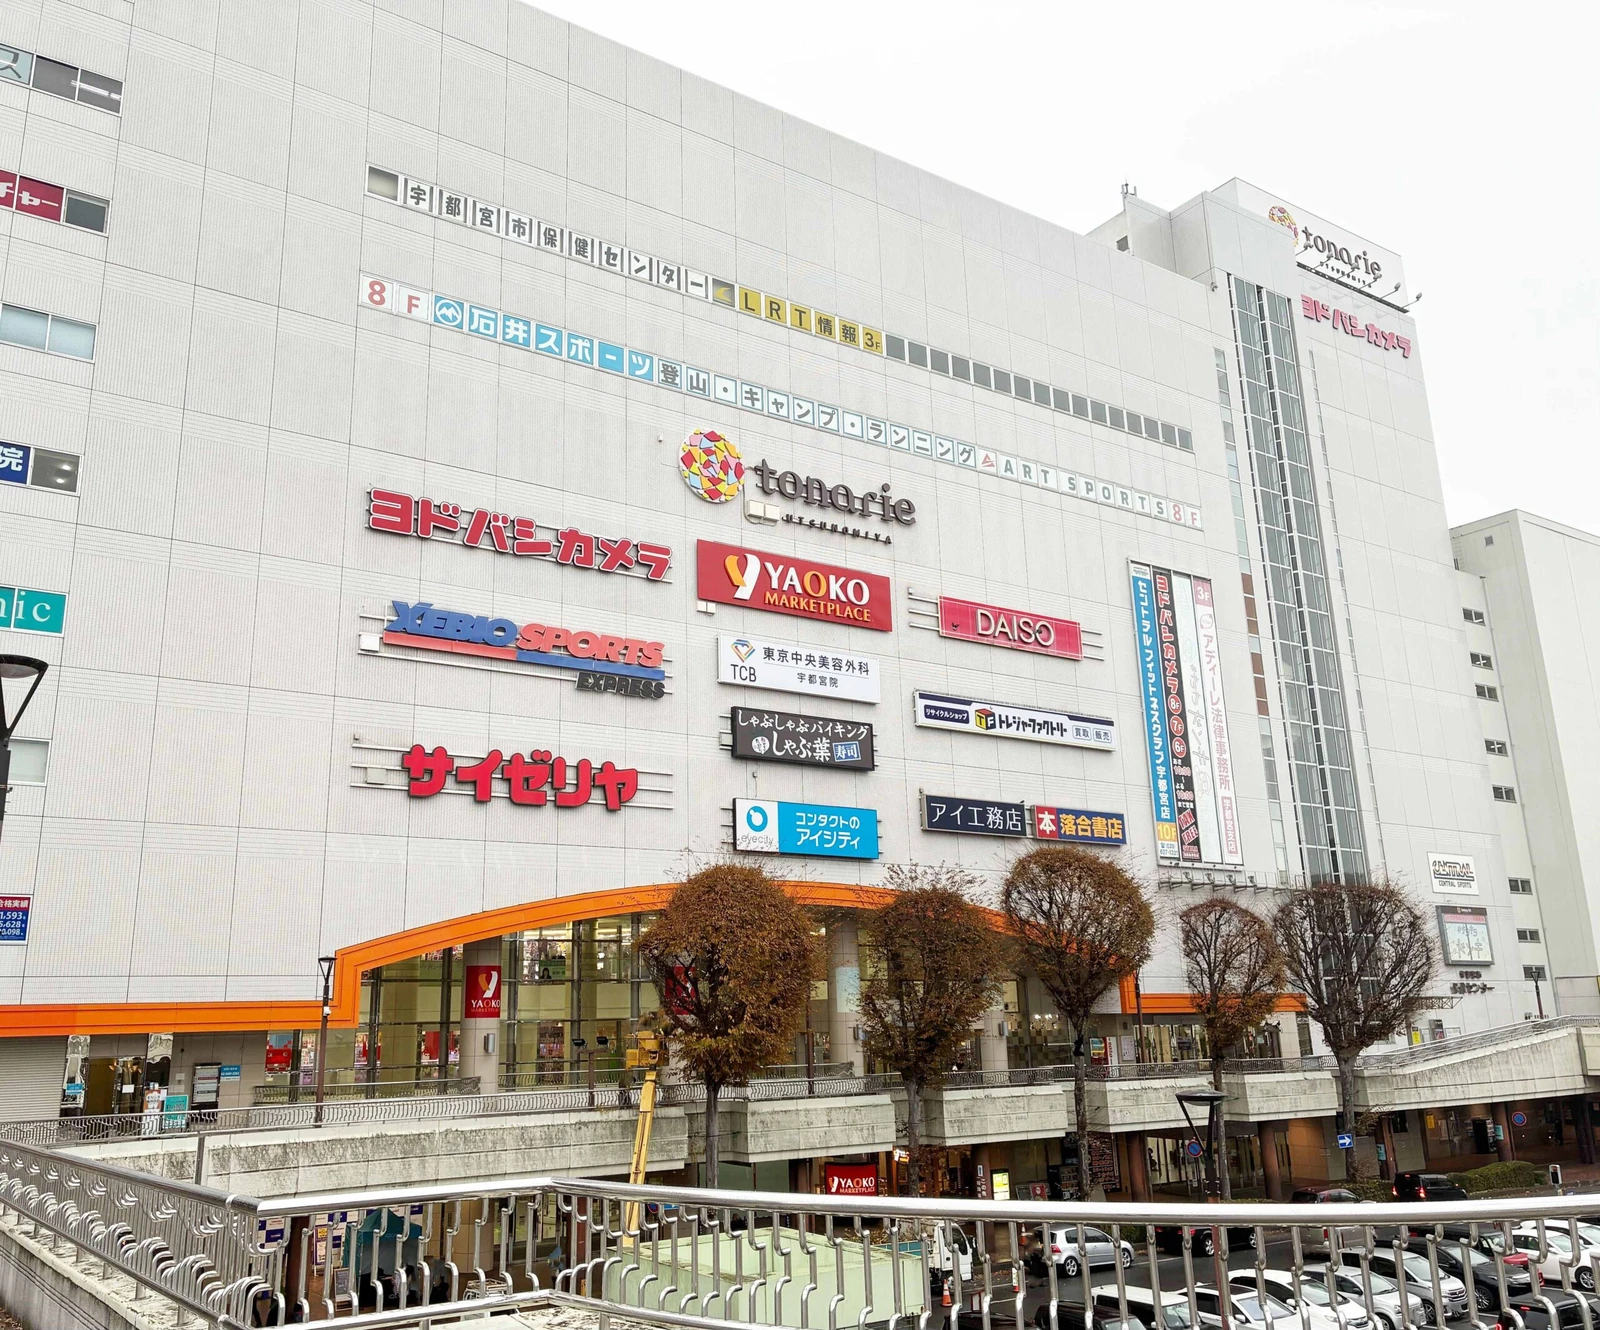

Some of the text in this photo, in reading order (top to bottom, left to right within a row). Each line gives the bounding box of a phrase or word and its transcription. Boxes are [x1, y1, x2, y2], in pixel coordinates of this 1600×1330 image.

[408, 184, 704, 289] 宇都宮市保健センター
[1302, 226, 1382, 278] tonarie
[1301, 294, 1412, 358] ヨドバシカメラ
[754, 458, 917, 526] tonarie
[369, 487, 673, 581] ヨドバシカメラ
[785, 512, 892, 544] UTSUNOMIYA
[764, 561, 870, 605] YAOKO
[1197, 586, 1210, 600] 3F
[765, 590, 871, 622] MARKETPLACE
[385, 600, 665, 668] XEBIO SPORTS
[976, 608, 1055, 646] DAISO
[1156, 574, 1179, 694] ヨドバシカメラ
[730, 663, 757, 683] TCB
[763, 646, 870, 676] 東京中央美容外科
[577, 672, 666, 699] EXPRESS
[797, 672, 839, 688] 宇都宮院
[1171, 698, 1181, 710] 8F
[1202, 633, 1230, 792] アディーレ法律事務所
[738, 709, 870, 741] しゃぶしゃぶバイキング
[925, 707, 968, 721] リサイクルショップ
[998, 714, 1068, 737] トレジャーファクトリー
[1172, 720, 1183, 731] 7F
[772, 730, 831, 762] しゃぶ葉
[835, 744, 858, 760] 寿司
[1174, 741, 1185, 753] 6F
[401, 744, 638, 811] サイゼリヤ
[796, 812, 861, 830] コンタクトの
[930, 802, 1022, 831] アイ工務店
[1037, 811, 1123, 840] 本 落合書店
[1178, 810, 1195, 830] TAX
[796, 828, 861, 849] アイシティ
[1182, 825, 1198, 845] FREE
[839, 1177, 875, 1189] YAOKO
